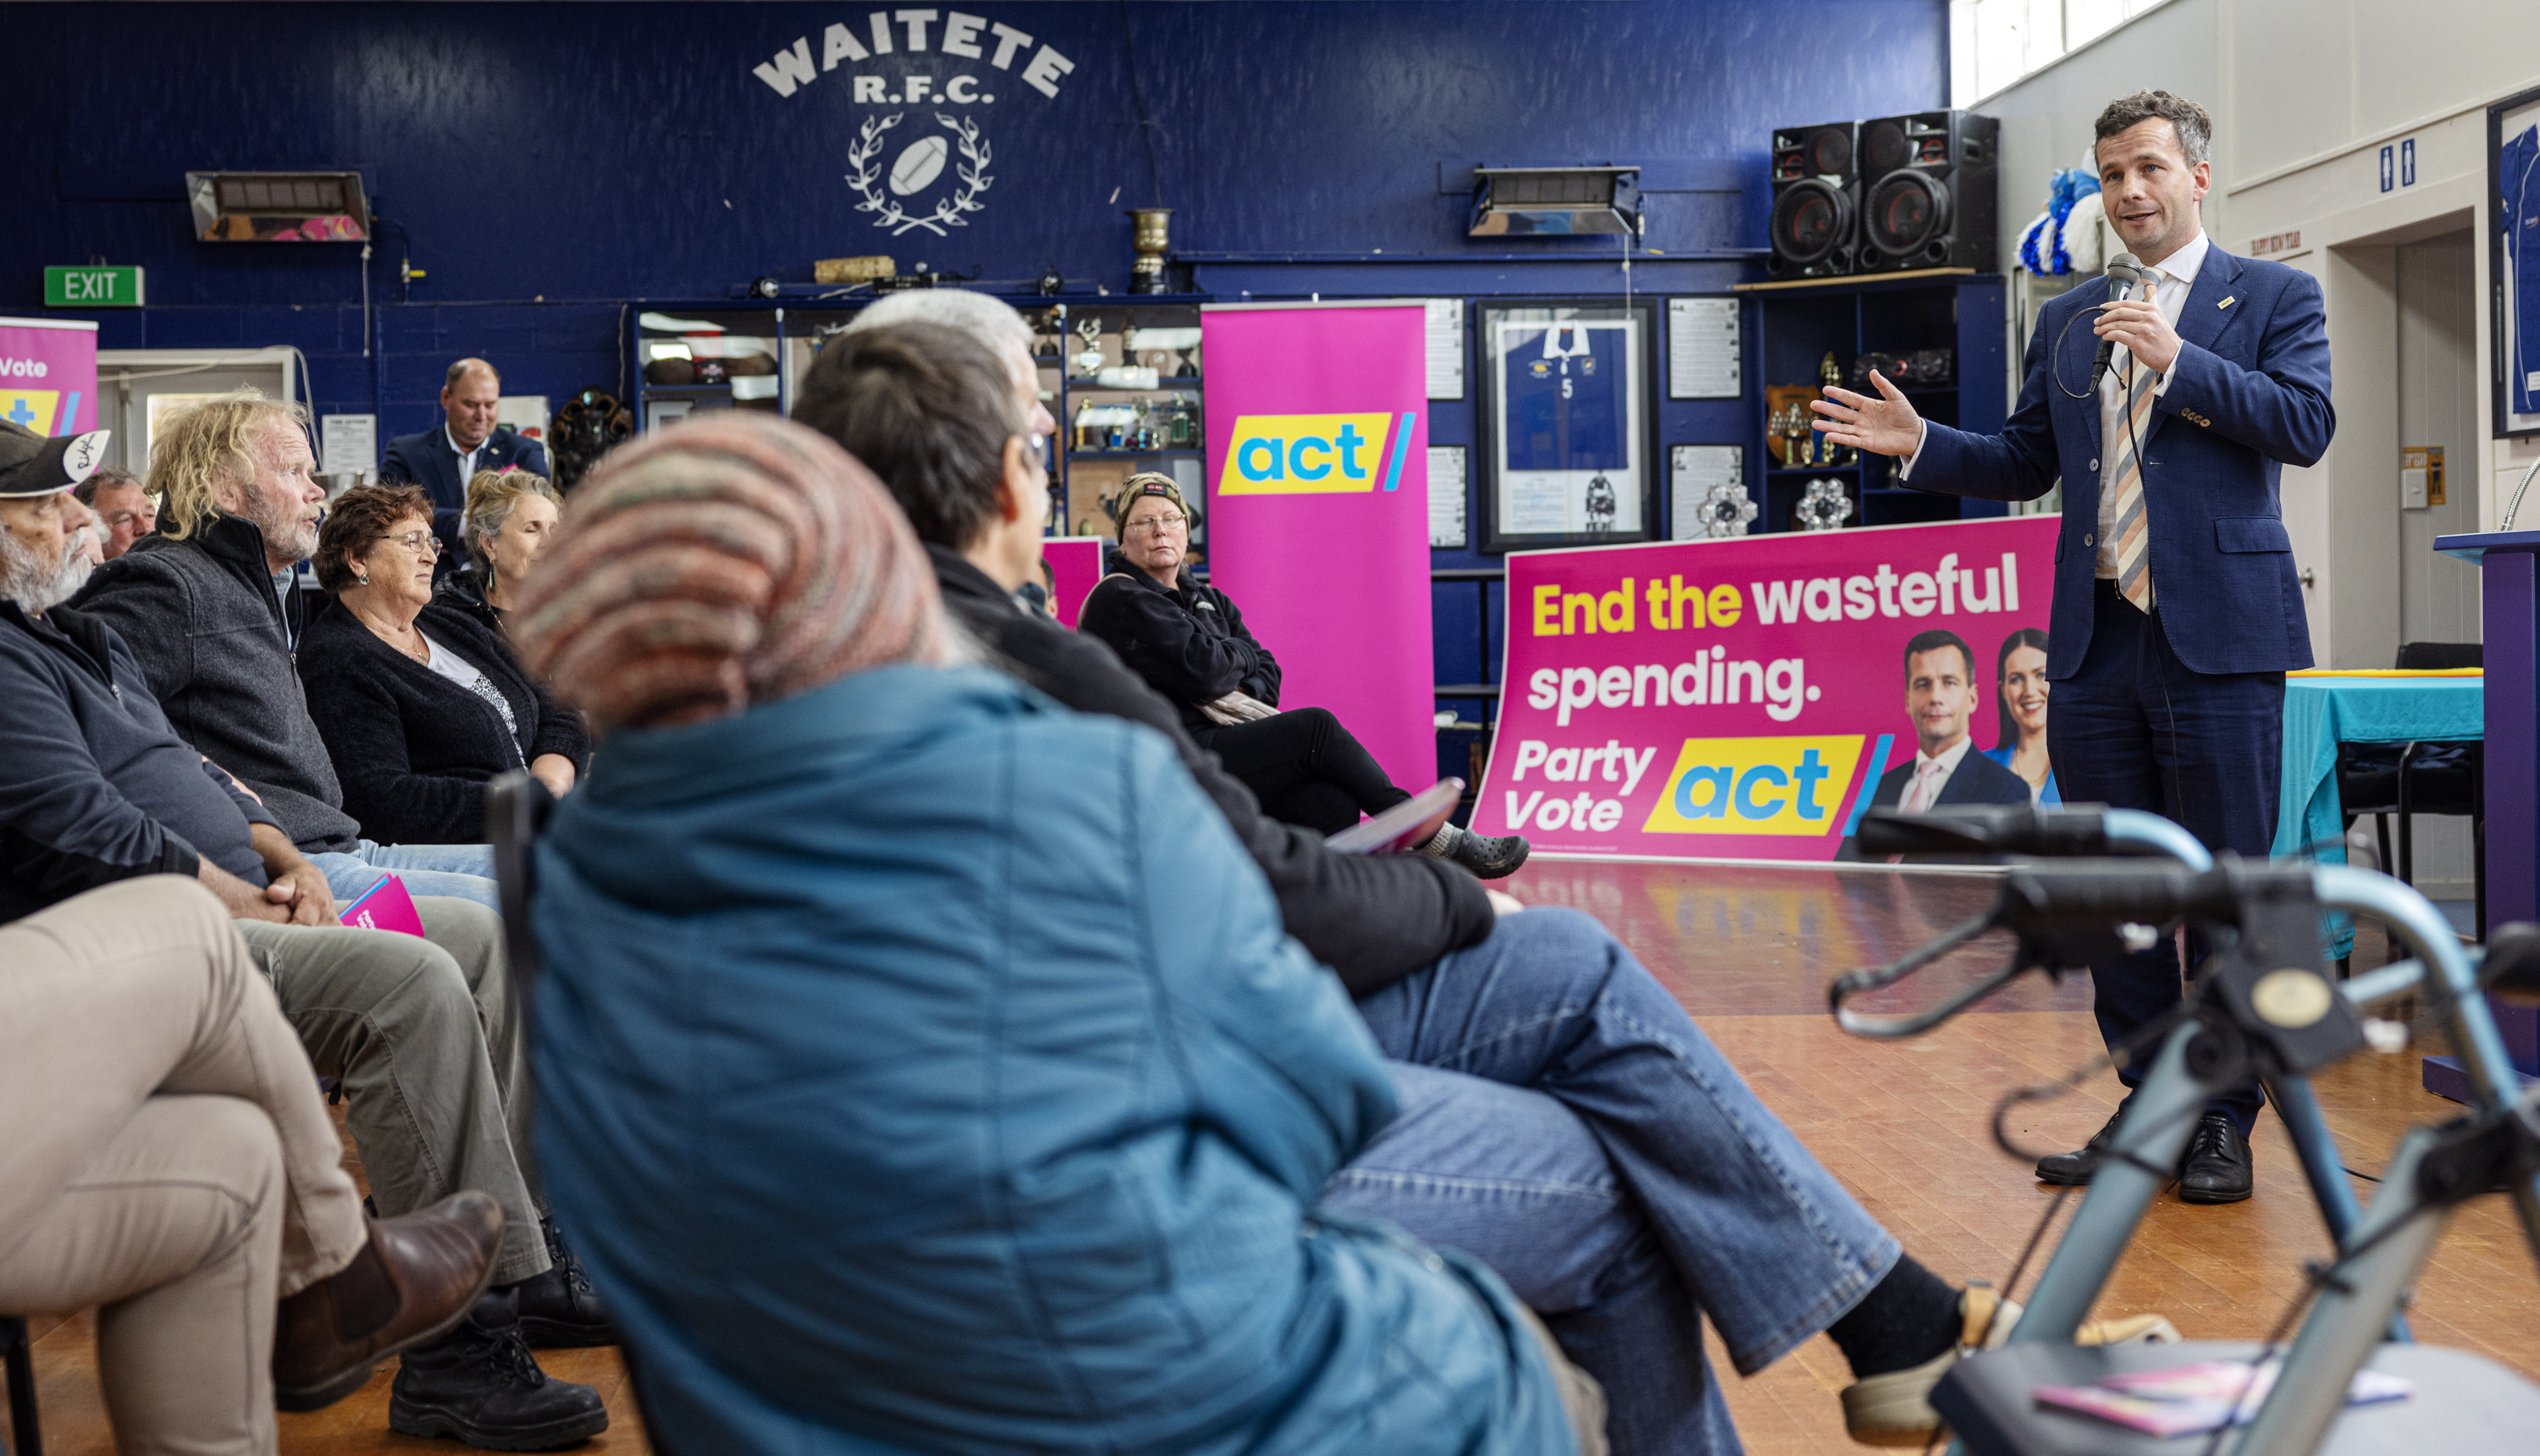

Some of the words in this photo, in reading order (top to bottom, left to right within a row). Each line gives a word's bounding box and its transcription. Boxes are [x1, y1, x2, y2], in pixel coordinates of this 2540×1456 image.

[752, 8, 1076, 99] WAITETE
[853, 74, 995, 104] R.F.C.
[65, 273, 117, 299] EXIT
[0, 357, 47, 378] Vote
[1562, 378, 1573, 399] 5
[1237, 423, 1367, 483] act
[1533, 577, 1635, 636] End
[1645, 575, 1742, 631] the
[1751, 552, 2019, 626] wasteful
[1527, 644, 1821, 726] spending.
[1512, 740, 1657, 796] Party
[1673, 748, 1830, 821] act
[1505, 791, 1623, 832] Vote
